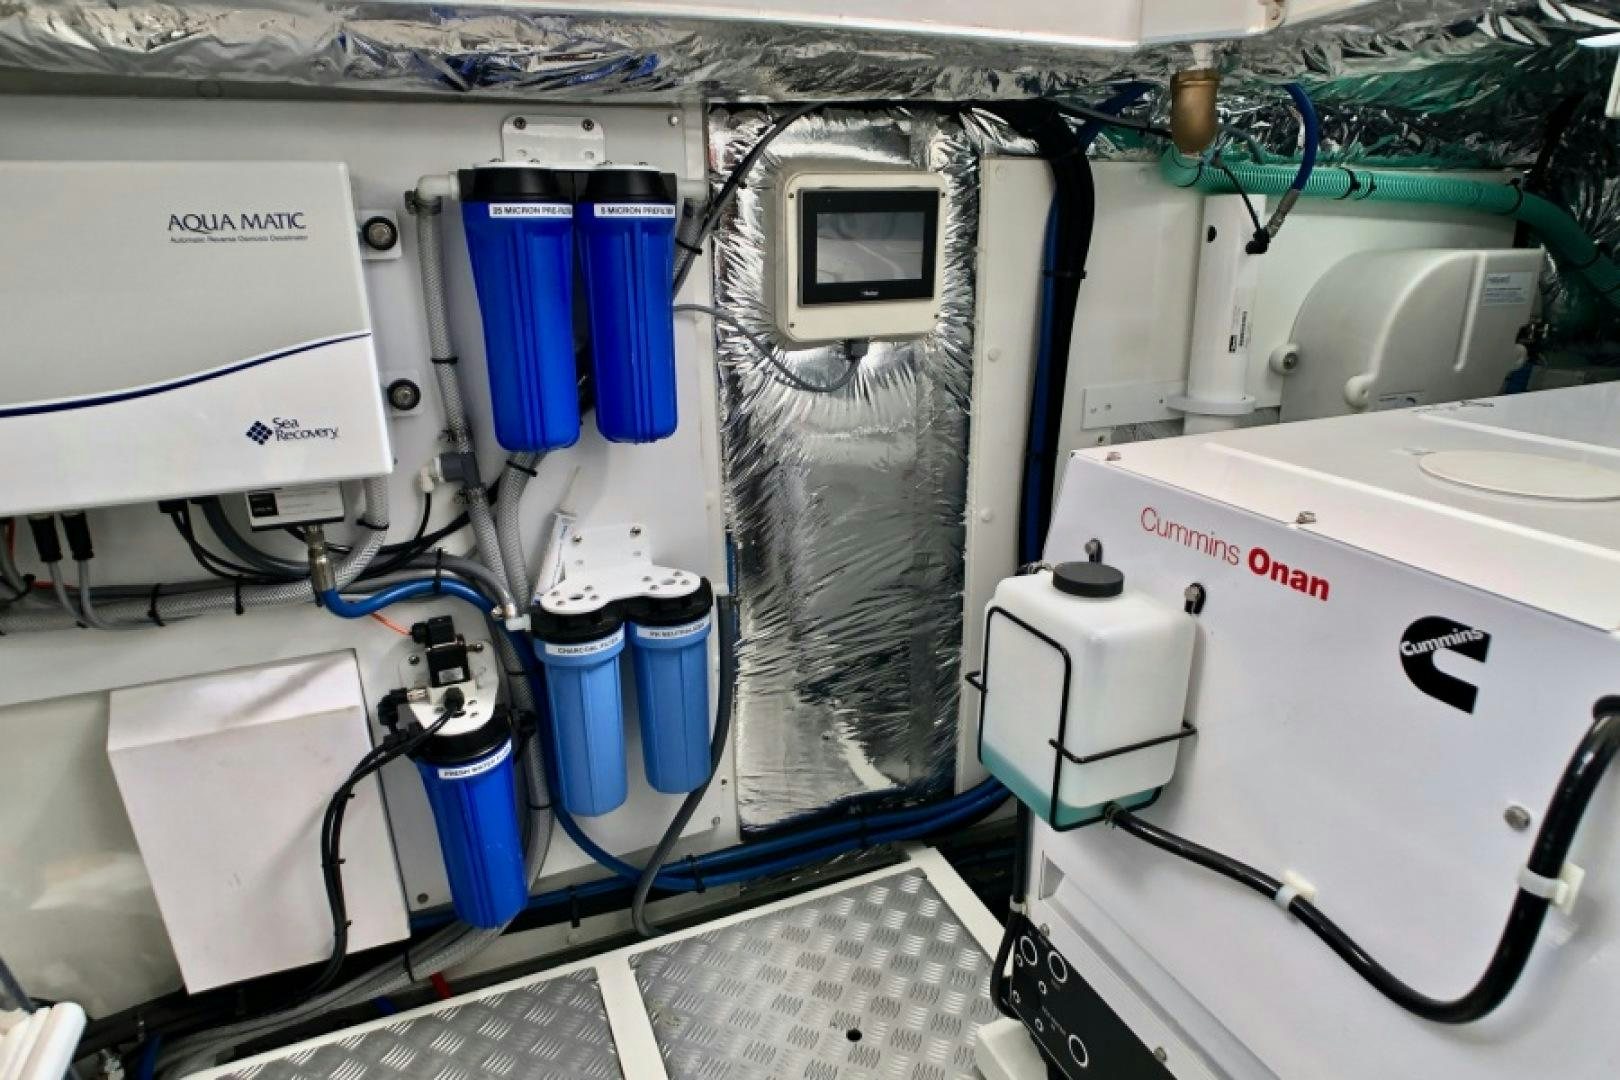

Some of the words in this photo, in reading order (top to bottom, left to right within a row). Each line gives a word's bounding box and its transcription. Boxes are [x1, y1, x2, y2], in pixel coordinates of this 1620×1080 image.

[504, 206, 541, 215] MICRON
[608, 206, 642, 215] MICRON
[168, 213, 237, 235] AQUA
[240, 212, 307, 230] MATIC
[272, 416, 299, 429] Sea
[1140, 506, 1241, 566] Cummins
[1248, 546, 1331, 602] Onan
[1401, 627, 1485, 657] Cummins
